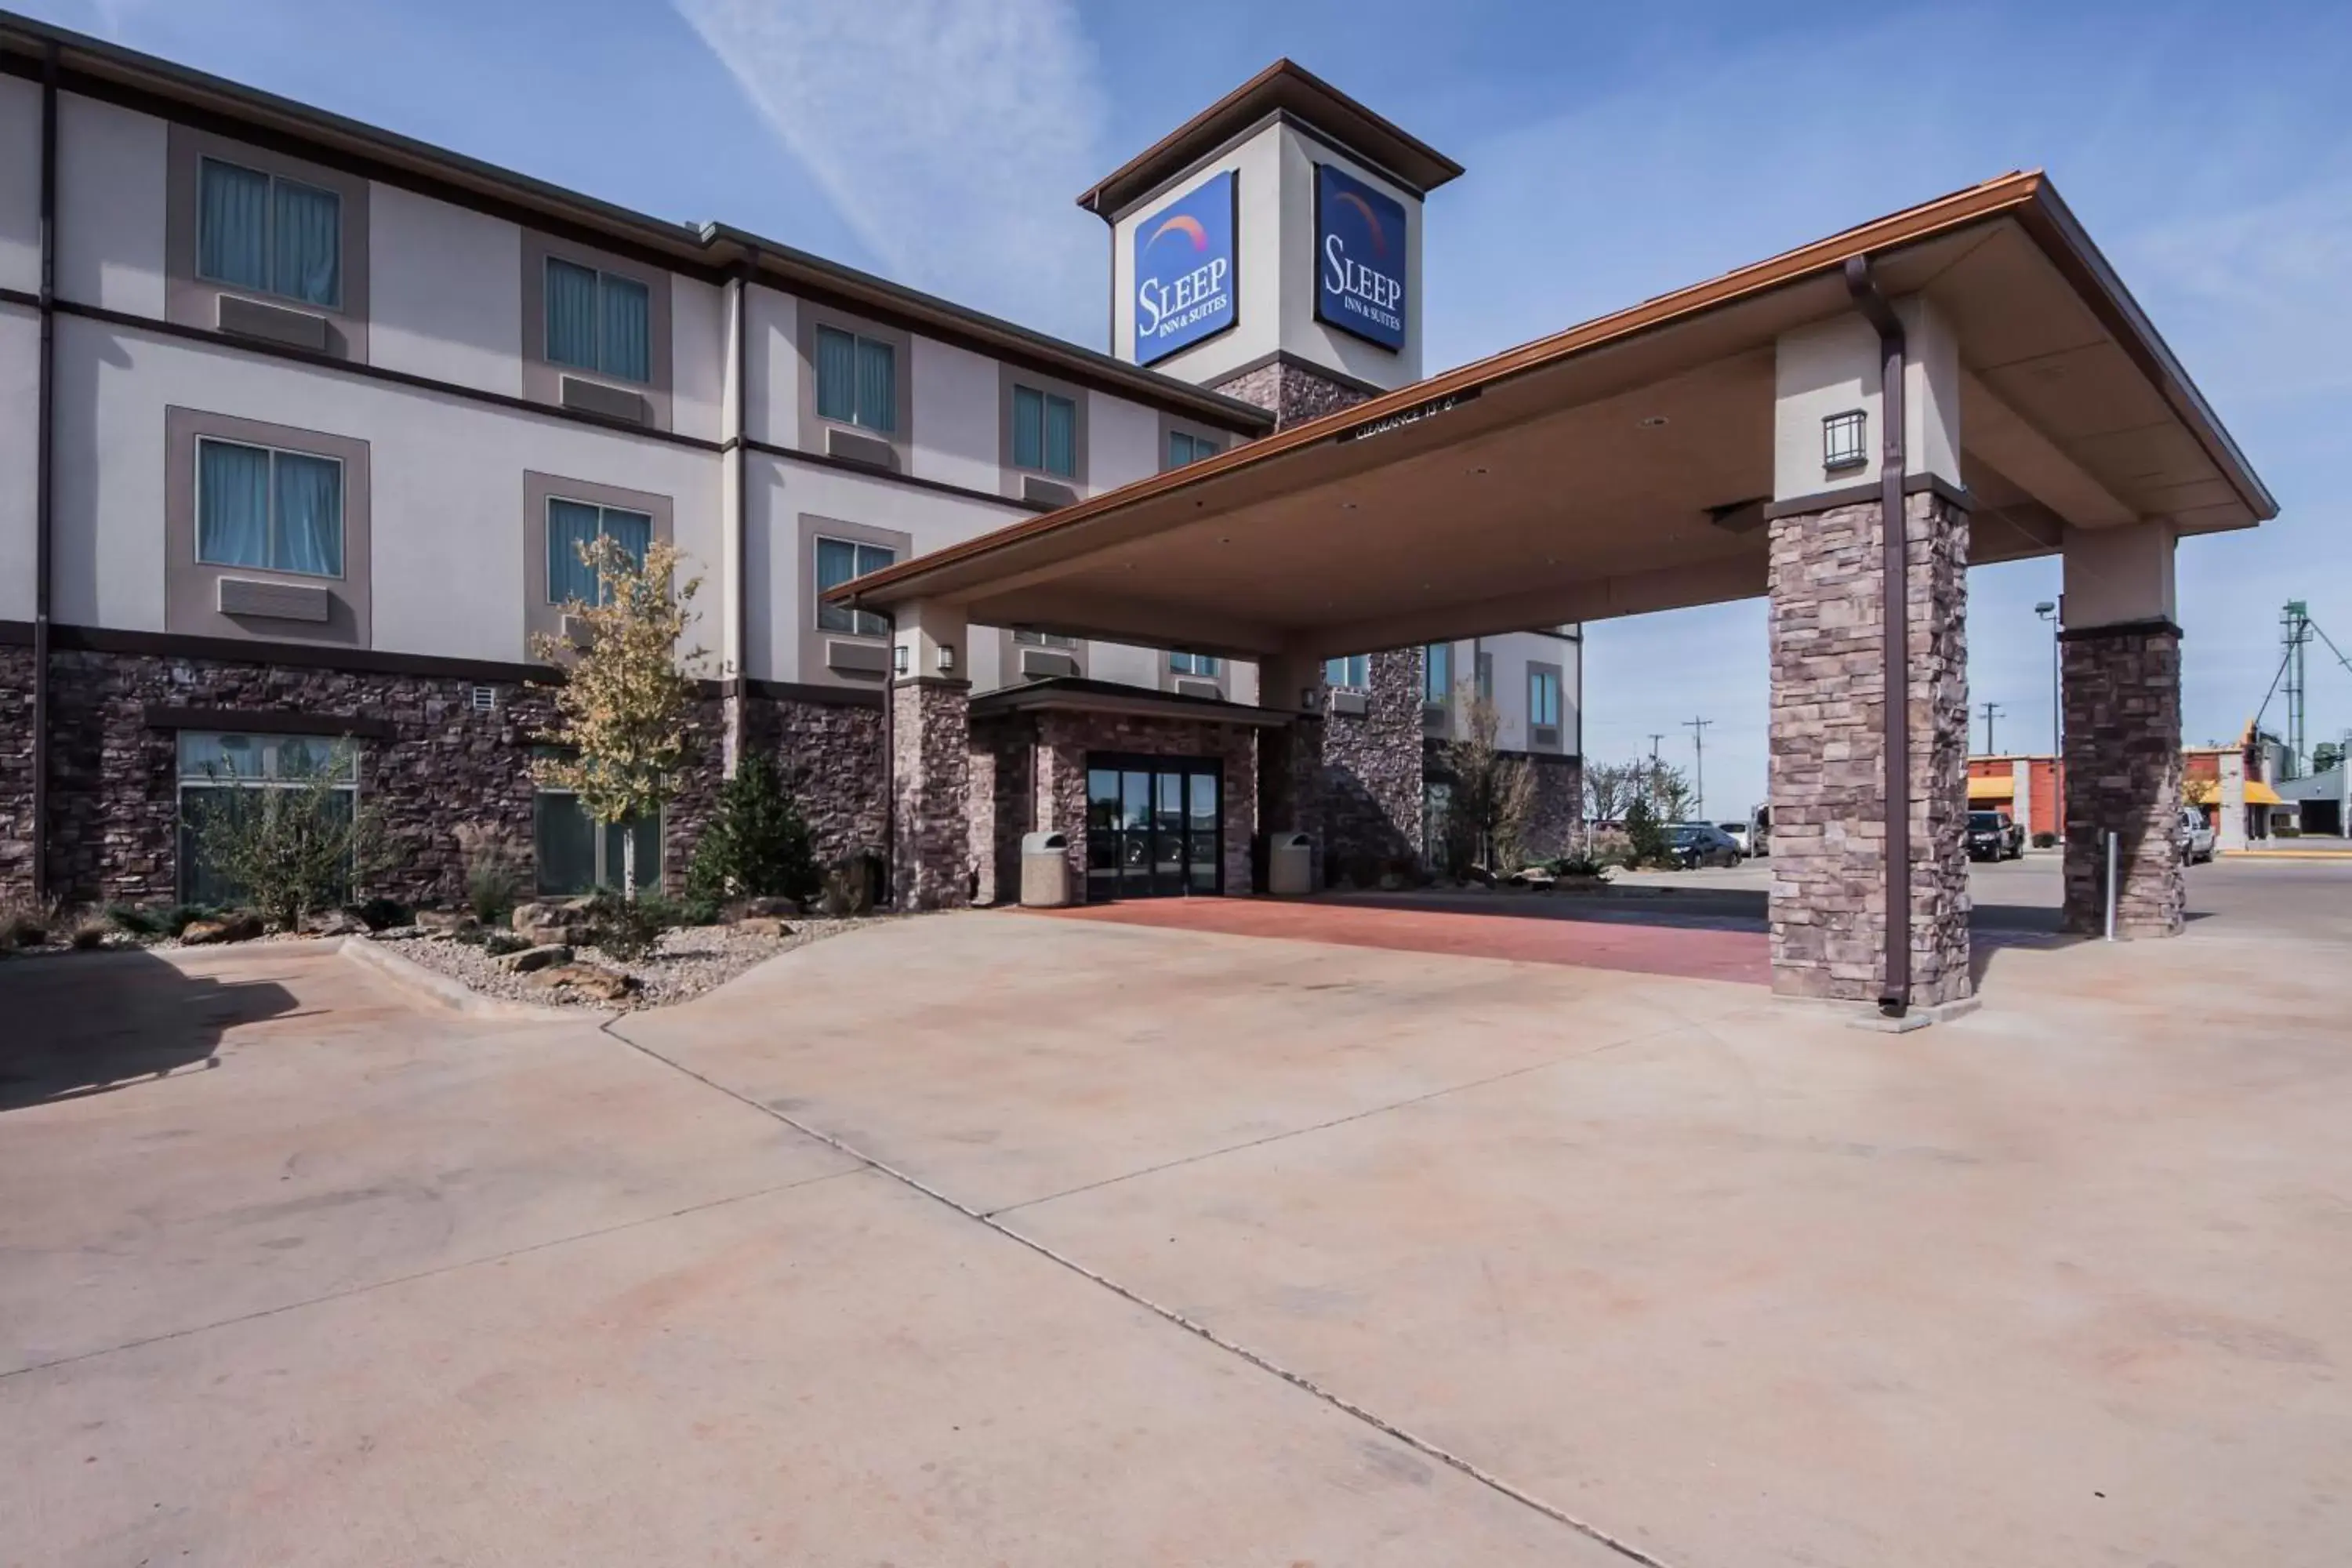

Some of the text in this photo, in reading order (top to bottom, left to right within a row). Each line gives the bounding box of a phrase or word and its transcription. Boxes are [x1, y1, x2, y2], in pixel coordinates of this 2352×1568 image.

[1139, 257, 1227, 339] SLEEP
[1324, 234, 1401, 311] SLEEP
[1160, 294, 1227, 339] INN & SUITES
[1345, 295, 1402, 331] INN & SUITES
